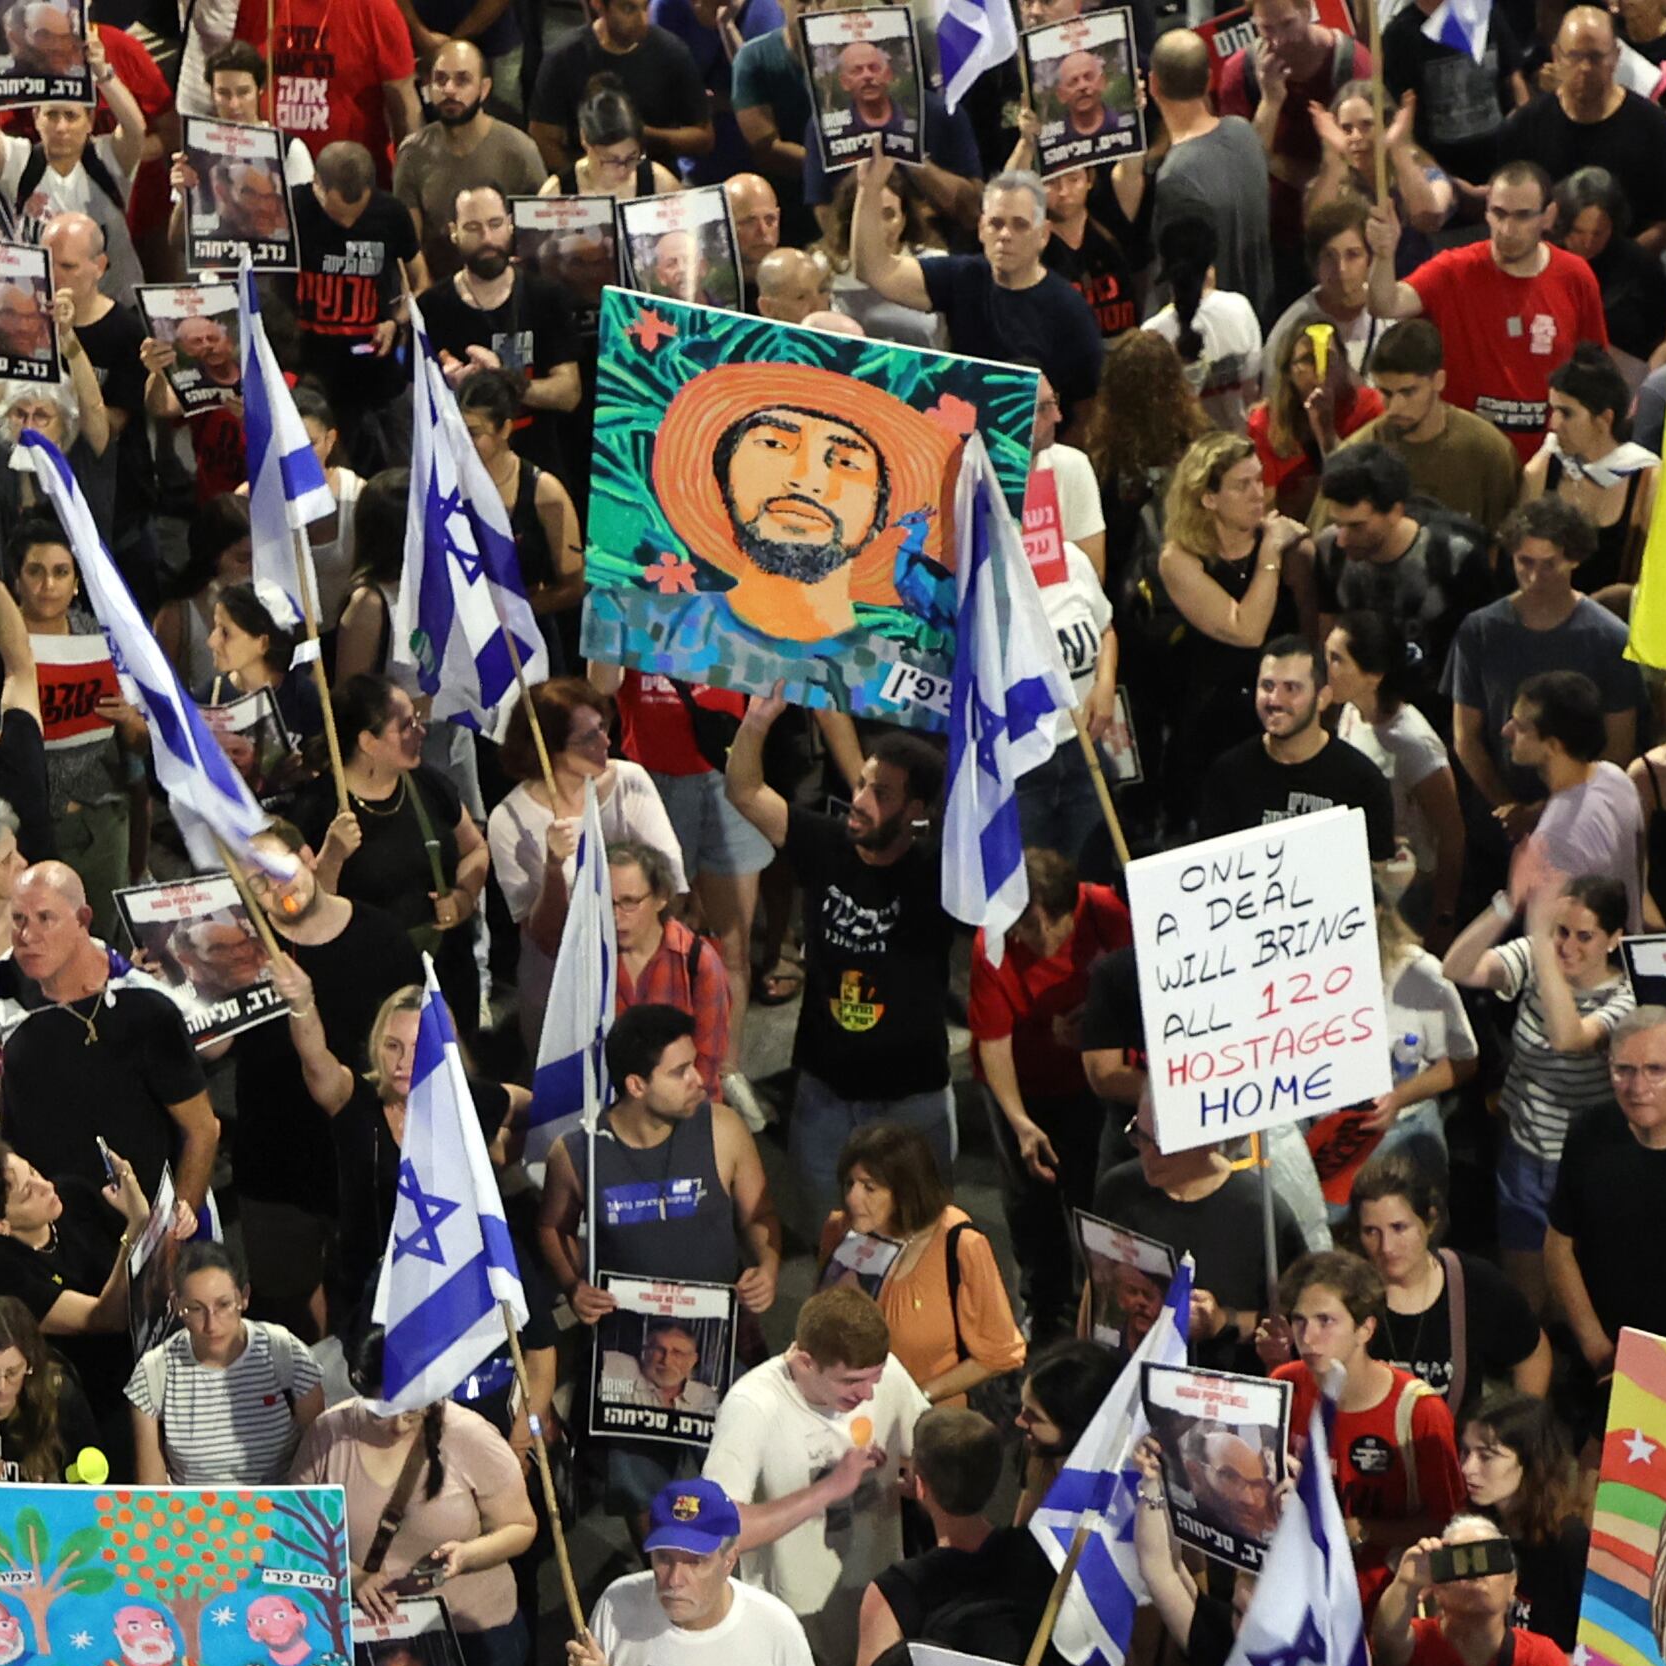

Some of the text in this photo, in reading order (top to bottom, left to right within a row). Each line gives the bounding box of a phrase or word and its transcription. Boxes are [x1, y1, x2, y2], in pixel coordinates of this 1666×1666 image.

[1177, 841, 1286, 895] ONLY
[1155, 877, 1315, 947] A DEAL
[1156, 905, 1368, 992] WILL BRING
[1161, 965, 1354, 1045] ALL 120
[1165, 1006, 1376, 1087] HOSTAGES
[1198, 1063, 1334, 1128] HOME
[265, 1570, 334, 1588] חיים פרי
